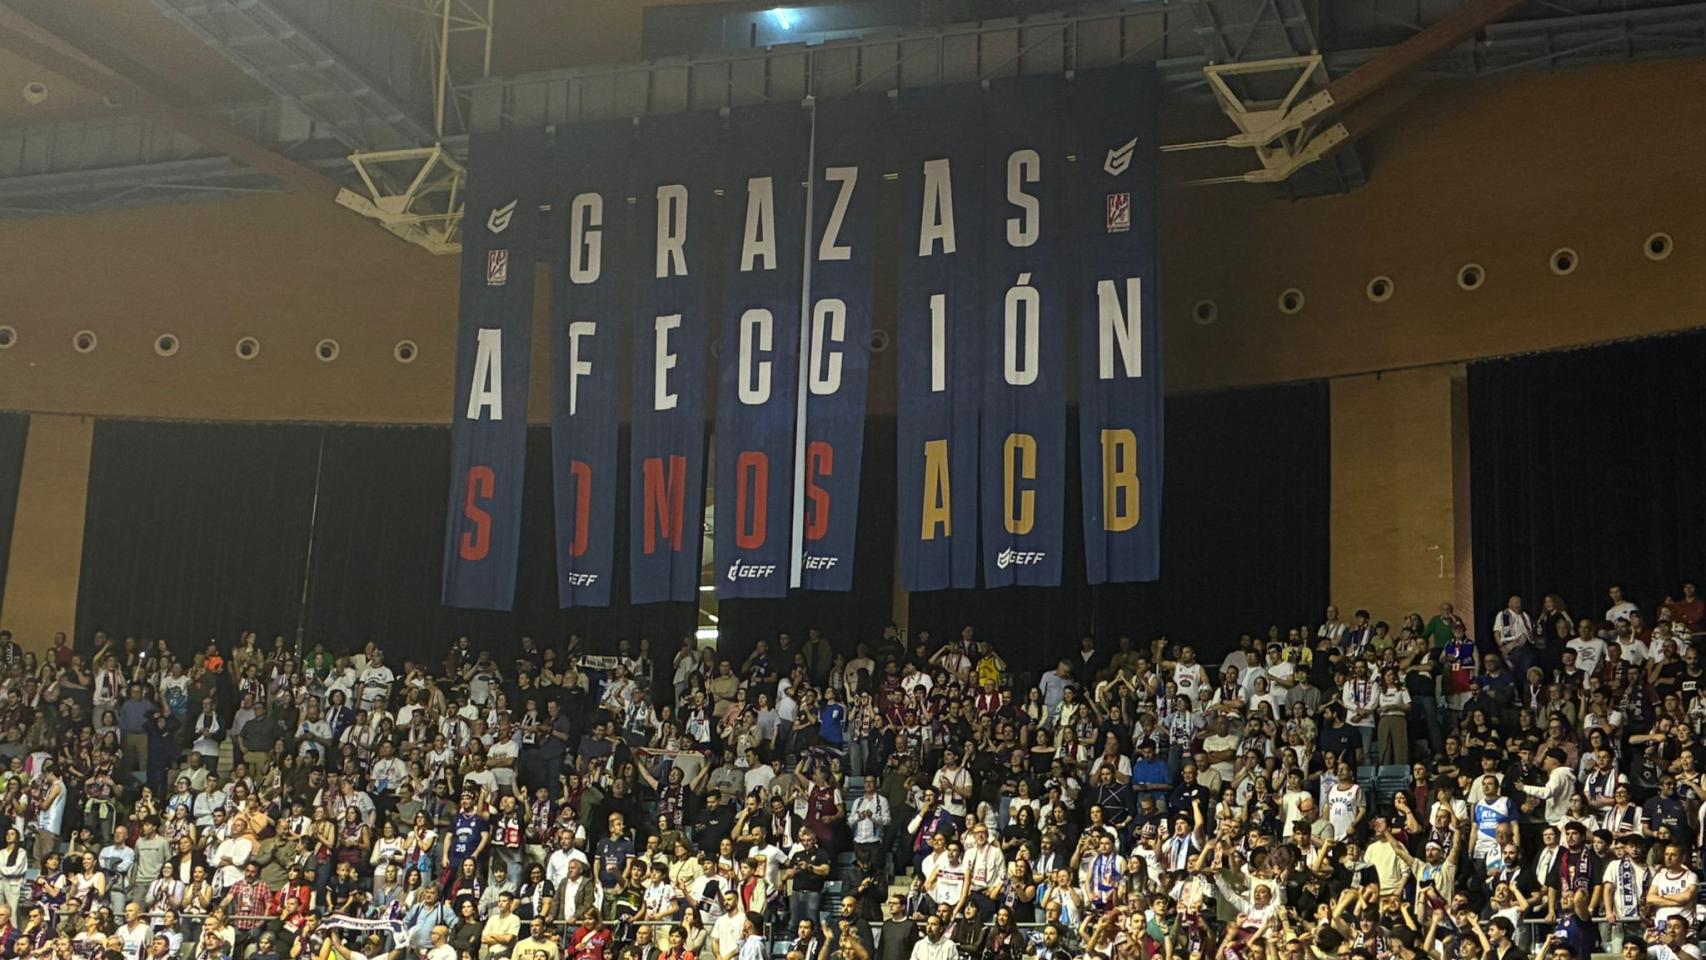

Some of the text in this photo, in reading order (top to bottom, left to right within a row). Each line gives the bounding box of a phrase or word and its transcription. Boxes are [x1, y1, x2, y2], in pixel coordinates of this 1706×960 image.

[570, 149, 1041, 284] GRAZAS
[466, 272, 1142, 420] AFECCIÓN
[920, 428, 1140, 541] ACB
[738, 565, 776, 578] GEFF
[1010, 550, 1046, 565] GEFF
